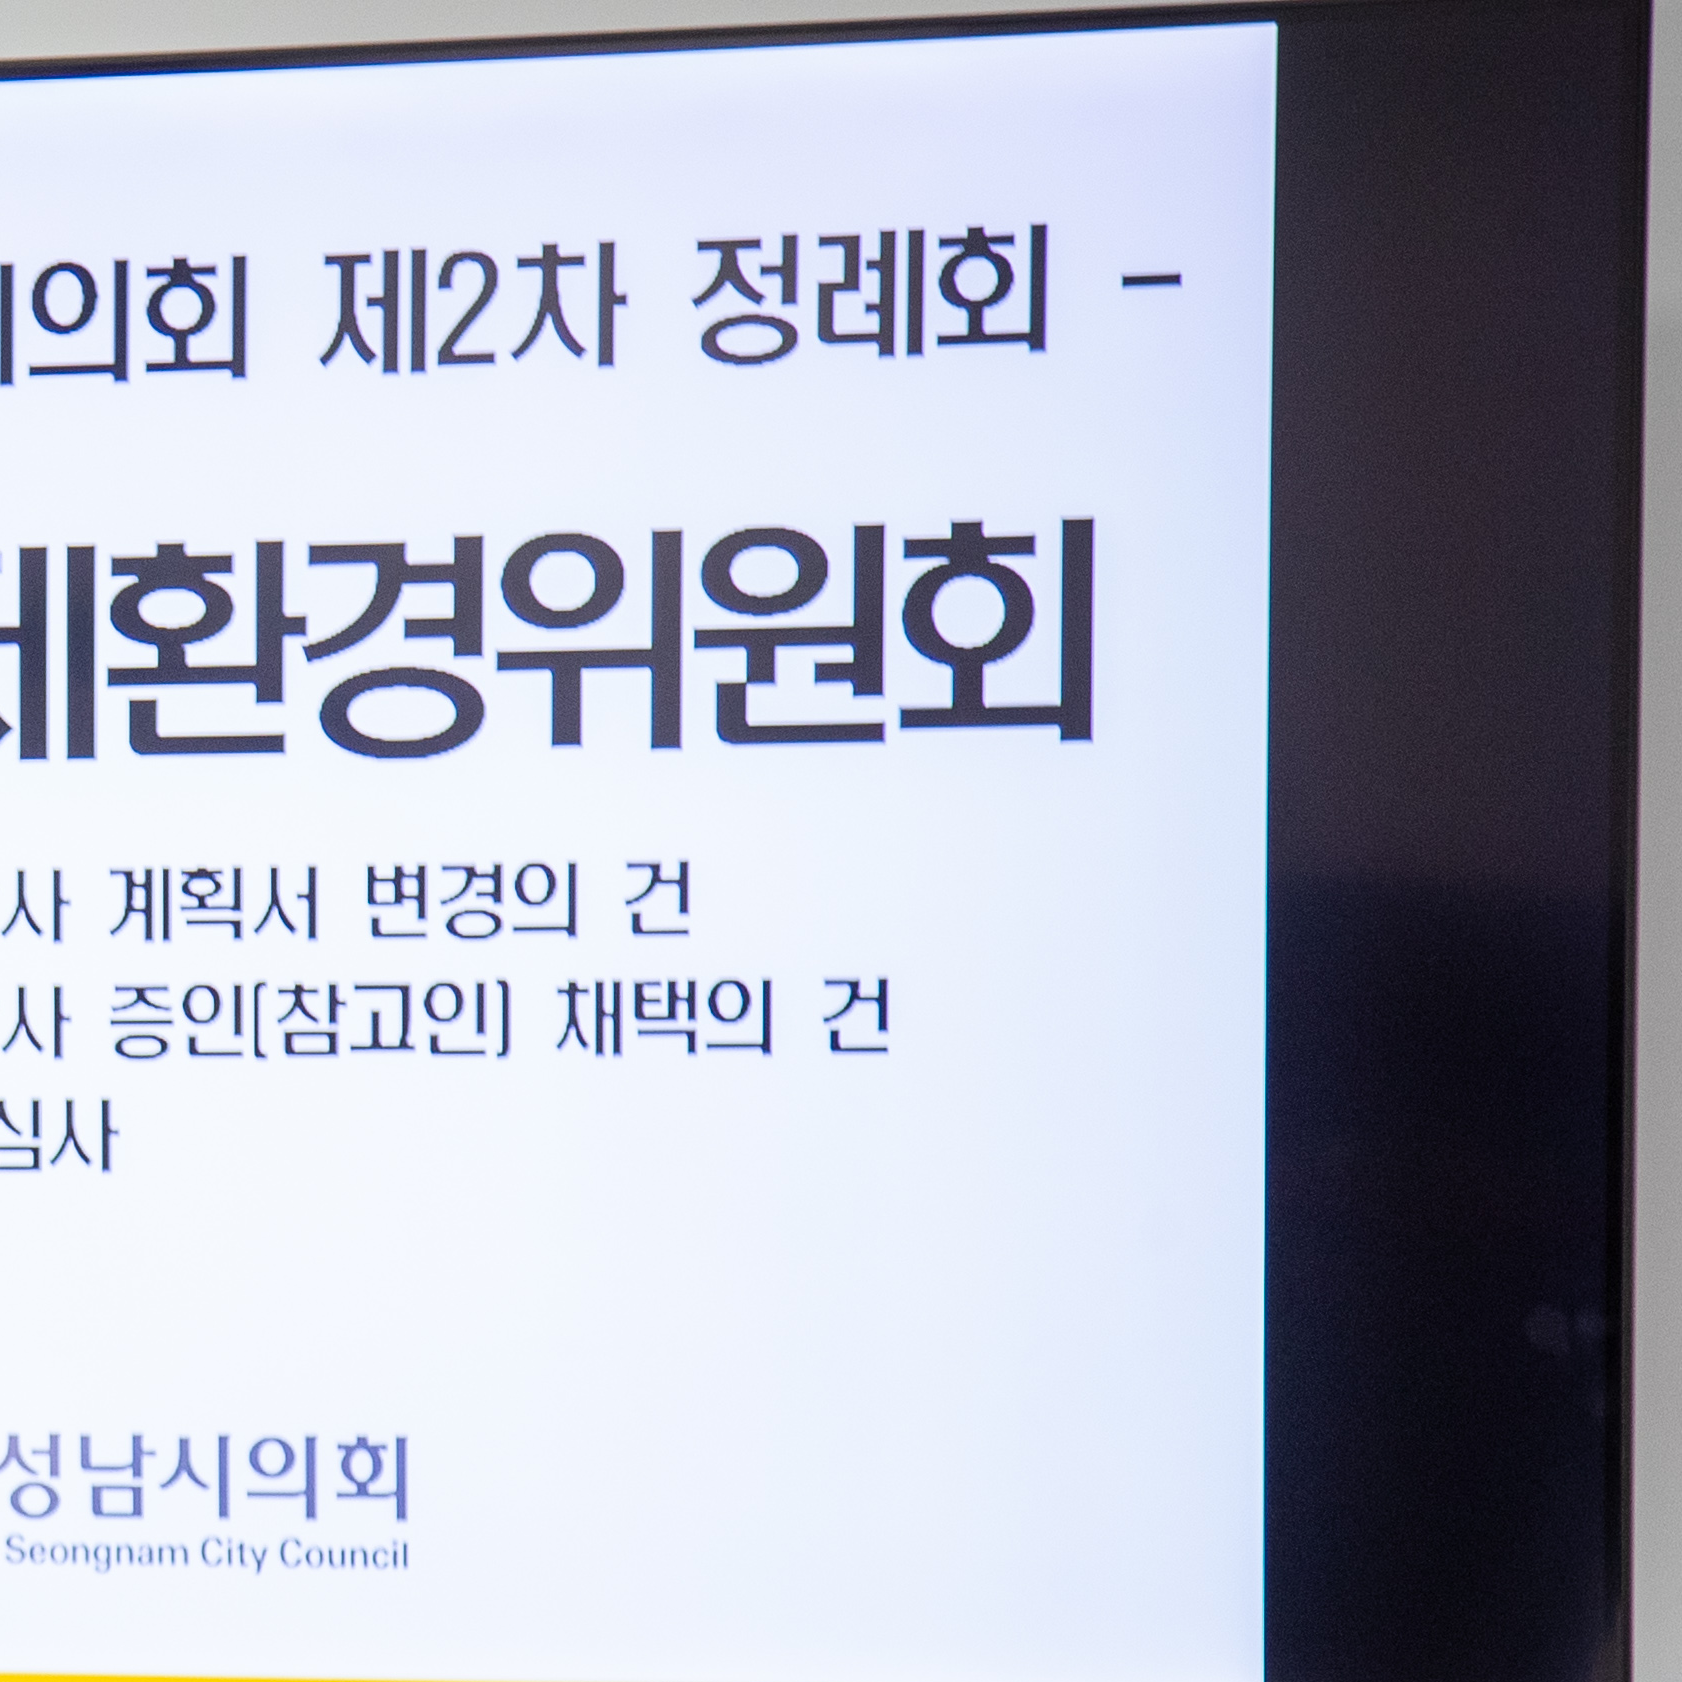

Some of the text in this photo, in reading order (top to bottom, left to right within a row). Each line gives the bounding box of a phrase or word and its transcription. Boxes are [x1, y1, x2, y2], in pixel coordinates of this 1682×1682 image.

[318, 241, 628, 375] 제2차
[691, 223, 1049, 367] 정례회
[109, 866, 317, 942] 계획서
[366, 862, 577, 940] 변경의
[624, 861, 689, 936] 건
[556, 979, 772, 1056] 채택의
[822, 978, 888, 1053] 건
[5, 1536, 408, 1574] Seongnam City Council
